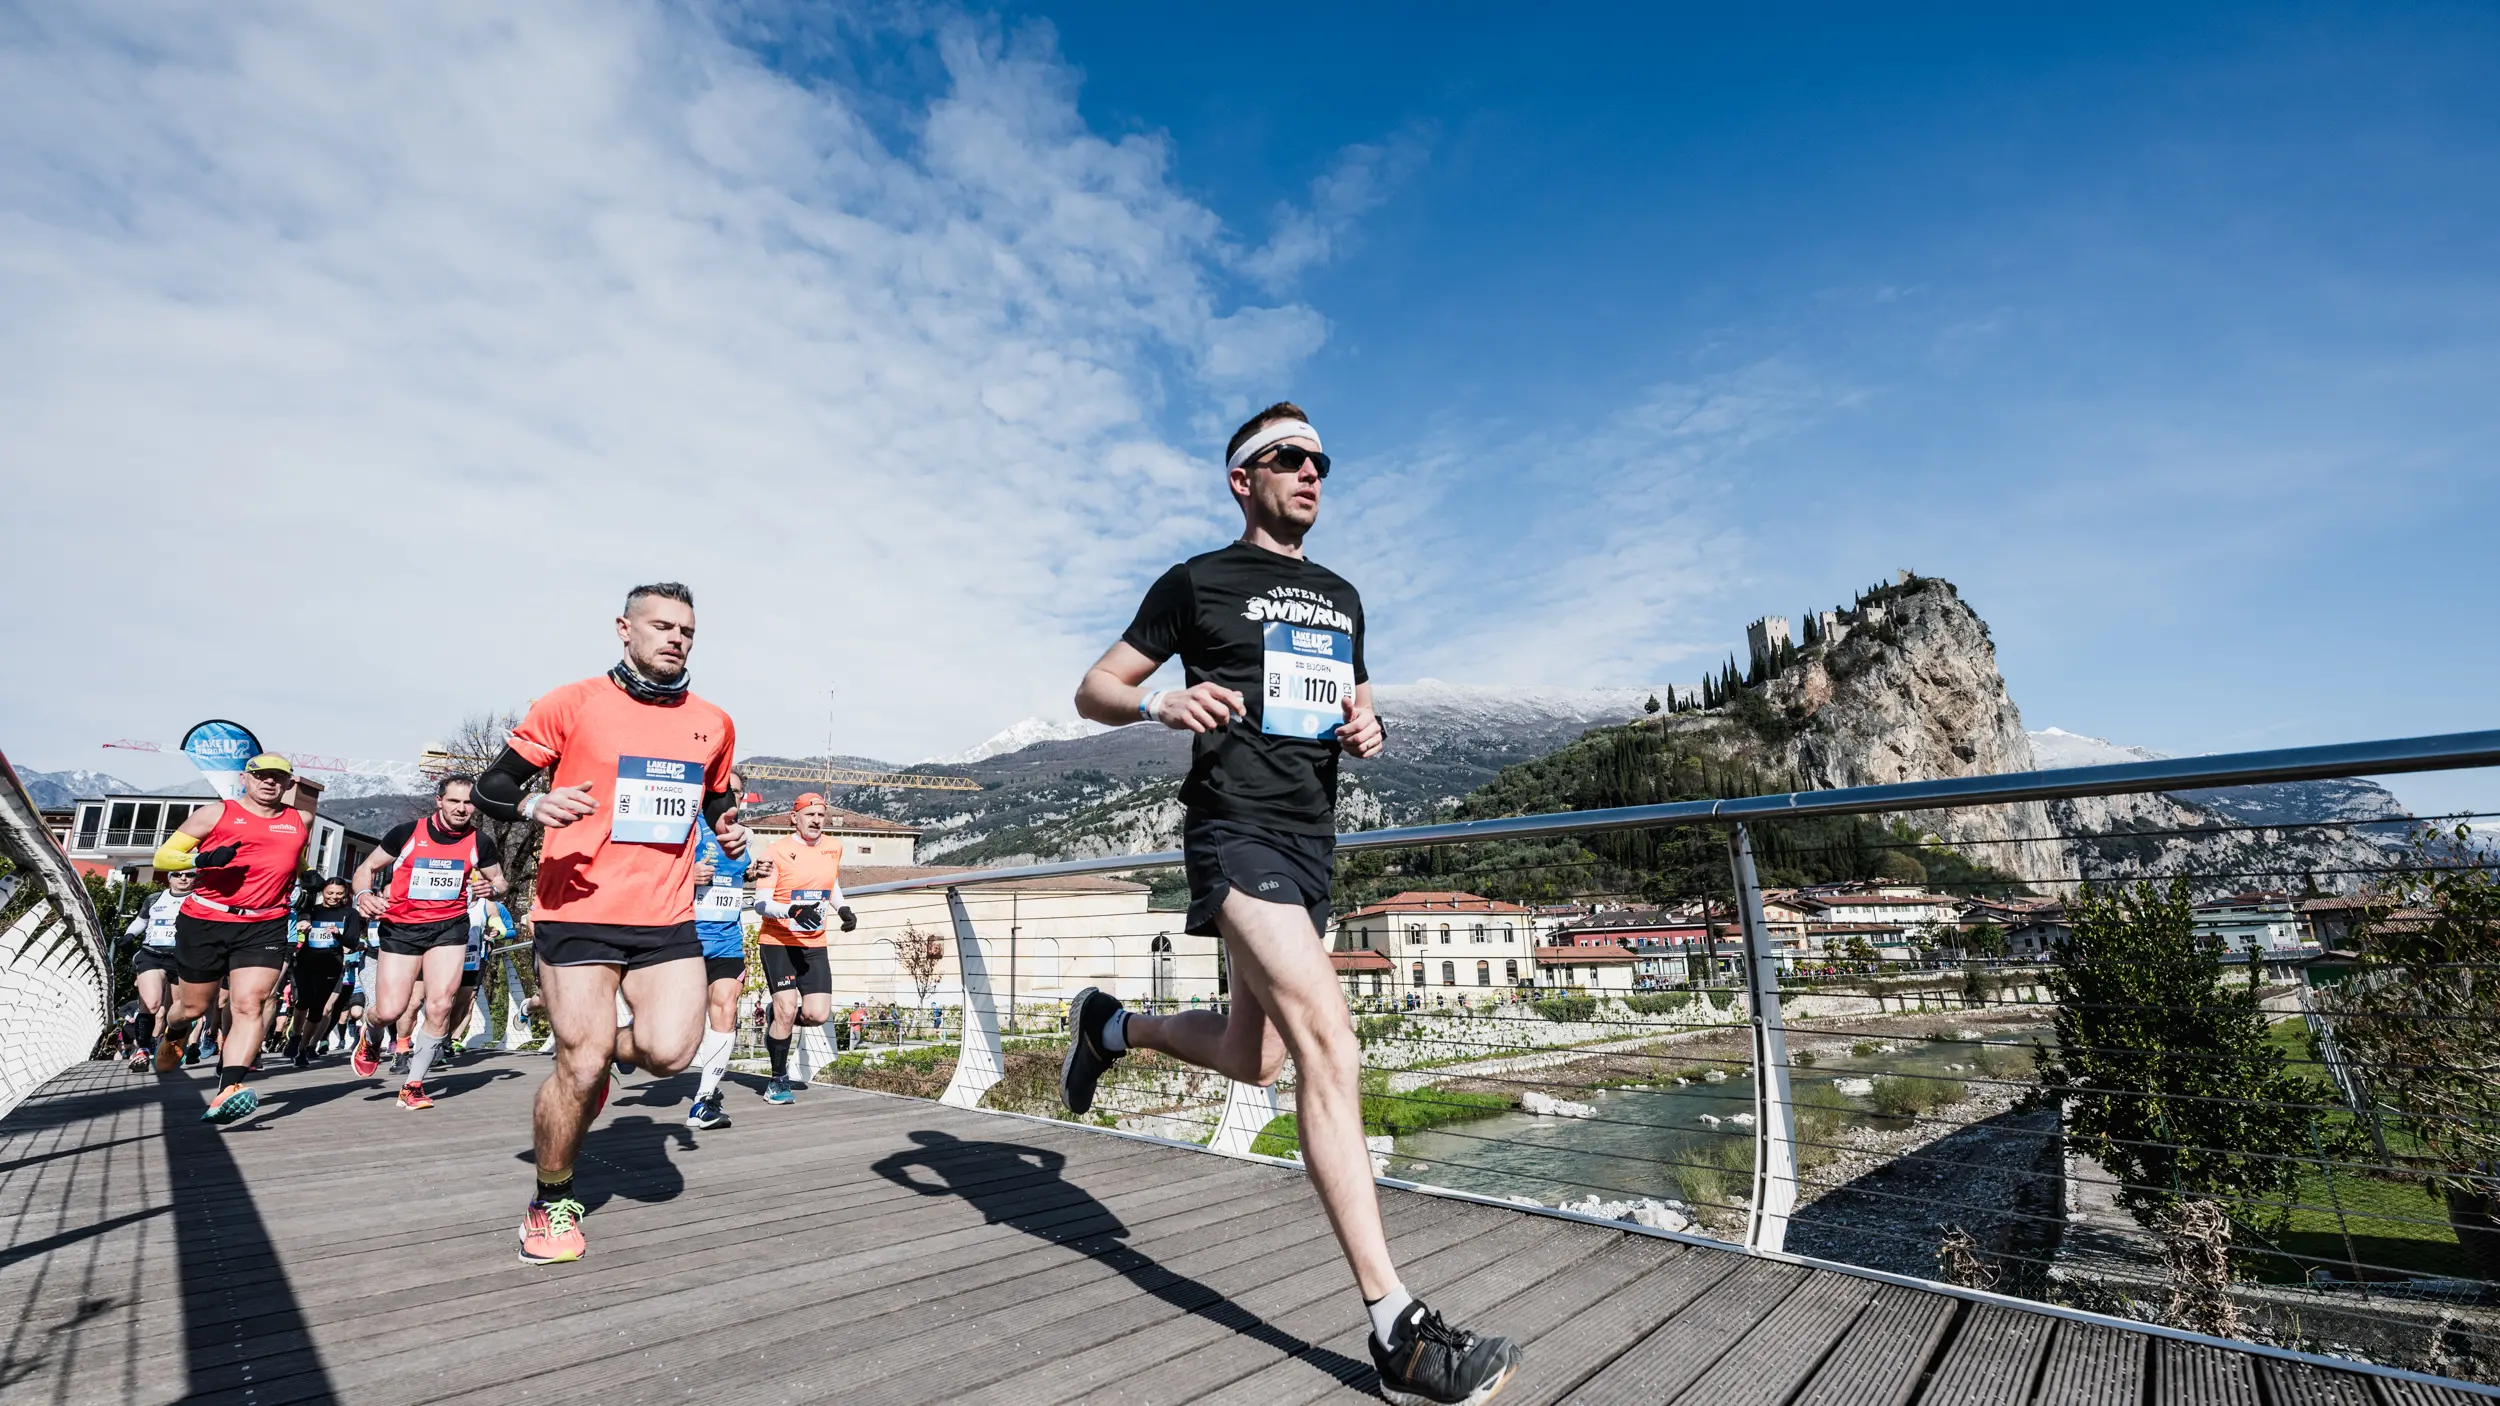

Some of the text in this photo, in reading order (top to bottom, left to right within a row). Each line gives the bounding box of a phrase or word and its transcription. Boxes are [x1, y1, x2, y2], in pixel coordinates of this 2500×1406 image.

[1292, 630, 1311, 643] LAKE
[194, 739, 223, 748] LAKE
[195, 747, 224, 755] GARDA
[646, 760, 667, 770] LAKE
[656, 786, 683, 794] MARCO
[430, 877, 453, 887] 1535
[716, 895, 733, 907] 1137
[778, 979, 790, 987] RUN
